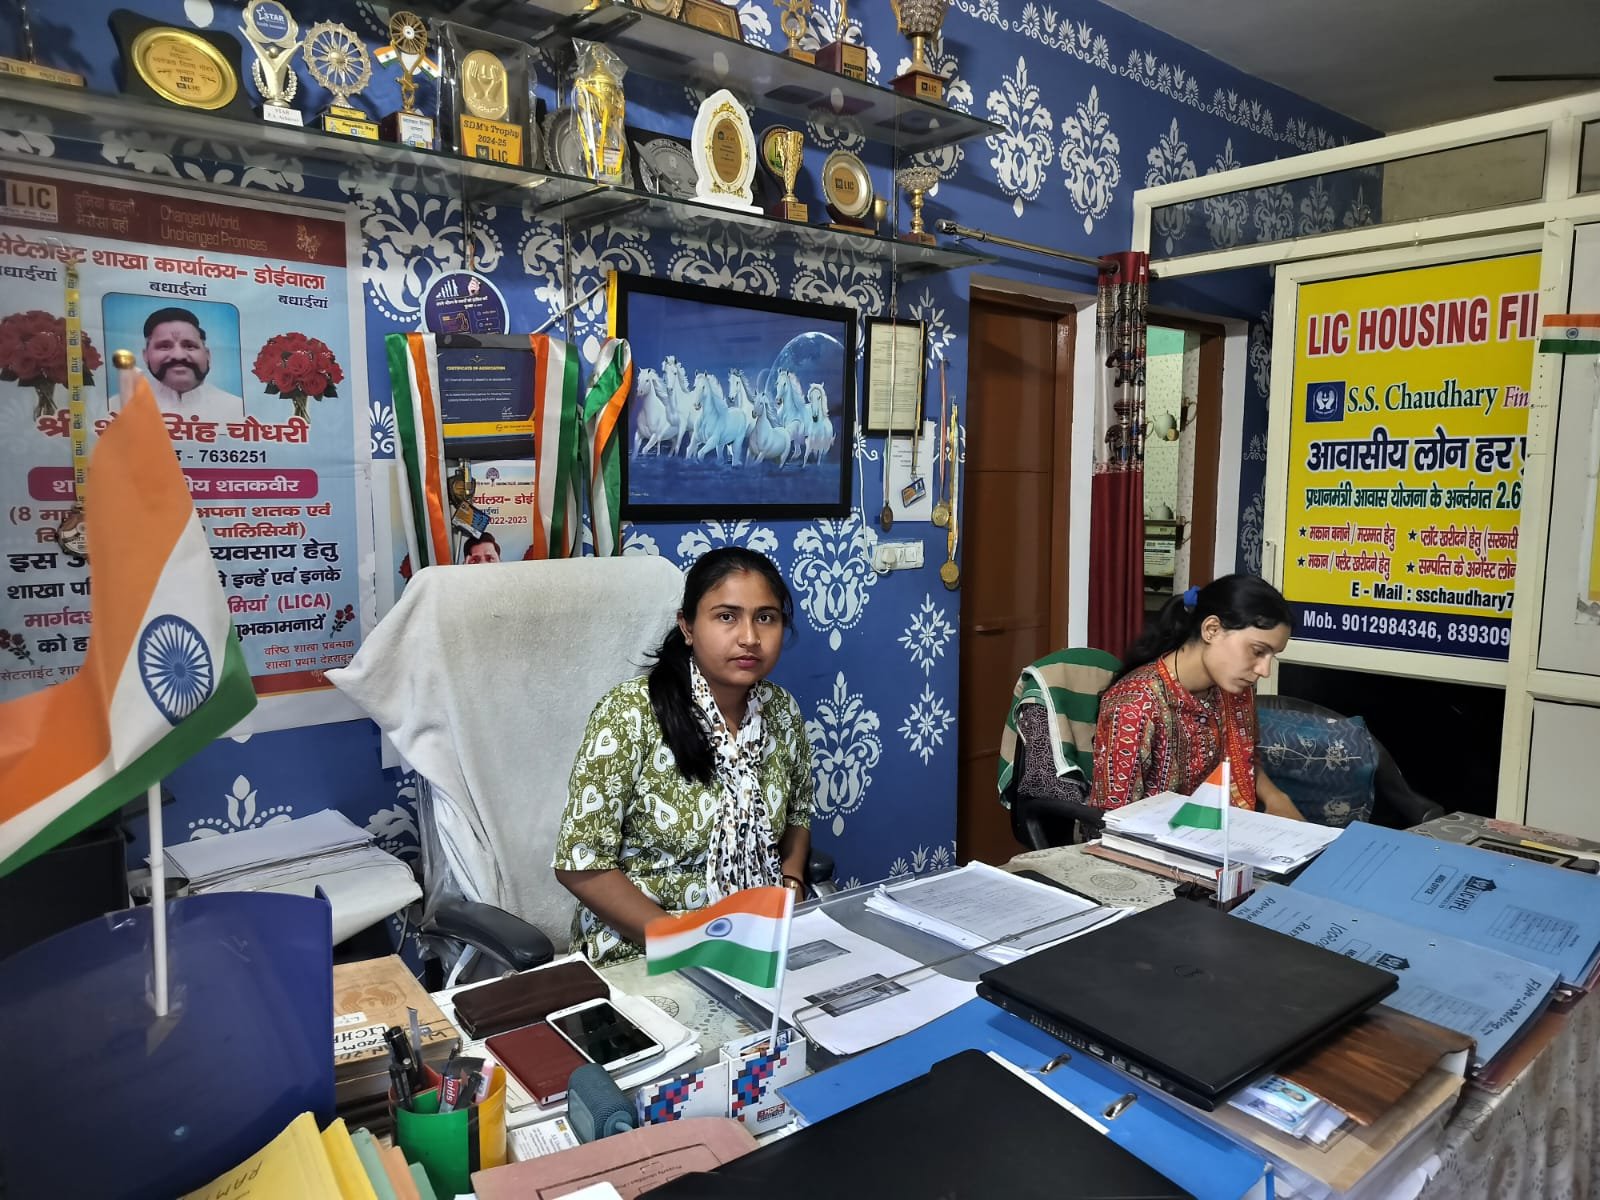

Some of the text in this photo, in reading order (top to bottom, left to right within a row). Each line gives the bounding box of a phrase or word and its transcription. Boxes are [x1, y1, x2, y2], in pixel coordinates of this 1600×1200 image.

[463, 119, 520, 139] SDM's Trophy
[477, 134, 507, 147] 2024-25
[491, 148, 509, 163] LIC
[11, 184, 51, 210] LIC
[160, 204, 206, 230] Changed
[161, 222, 220, 248] Unchanged
[93, 249, 149, 271] शाखा
[254, 264, 326, 290] डोईवाला
[149, 280, 208, 298] बधाईयां
[278, 292, 329, 310] बधाईयां
[1307, 313, 1349, 356] LIC
[1358, 298, 1488, 351] HOUSING
[1348, 386, 1379, 412] S.S.
[1385, 379, 1498, 415] Chaudhary
[227, 412, 311, 444] चौधरी
[199, 449, 267, 464] 7636251
[1307, 427, 1409, 471] आवासीय
[1414, 426, 1469, 471] लोन
[1475, 437, 1515, 473] हर
[216, 475, 301, 493] शतकवीर
[1306, 481, 1352, 510] प्रधानमंत्री
[1355, 488, 1389, 508] आवास
[1391, 482, 1427, 508] योजना
[1429, 481, 1442, 508] के
[251, 506, 302, 518] शतक
[306, 502, 332, 518] एवं
[1309, 526, 1331, 542] मकान
[1383, 523, 1396, 551] हेतु
[1439, 525, 1468, 548] खरीदने
[1468, 526, 1482, 556] हेतु
[6, 552, 59, 573] इस
[302, 538, 338, 563] हेतु
[1308, 554, 1329, 569] मकान
[1352, 551, 1378, 572] खरीदने
[1378, 552, 1391, 580] हेतु
[1453, 555, 1465, 576] के
[7, 583, 65, 600] शाखा
[271, 566, 298, 586] एवं
[299, 565, 342, 586] इनके
[277, 593, 331, 613] (LICA)
[1352, 582, 1360, 597] E
[1373, 583, 1403, 601] Mail
[1416, 587, 1515, 612] sschaudhary7
[1303, 610, 1511, 647] Mob. 9012984346, 839309
[37, 633, 68, 654] को
[294, 643, 319, 653] शाखा
